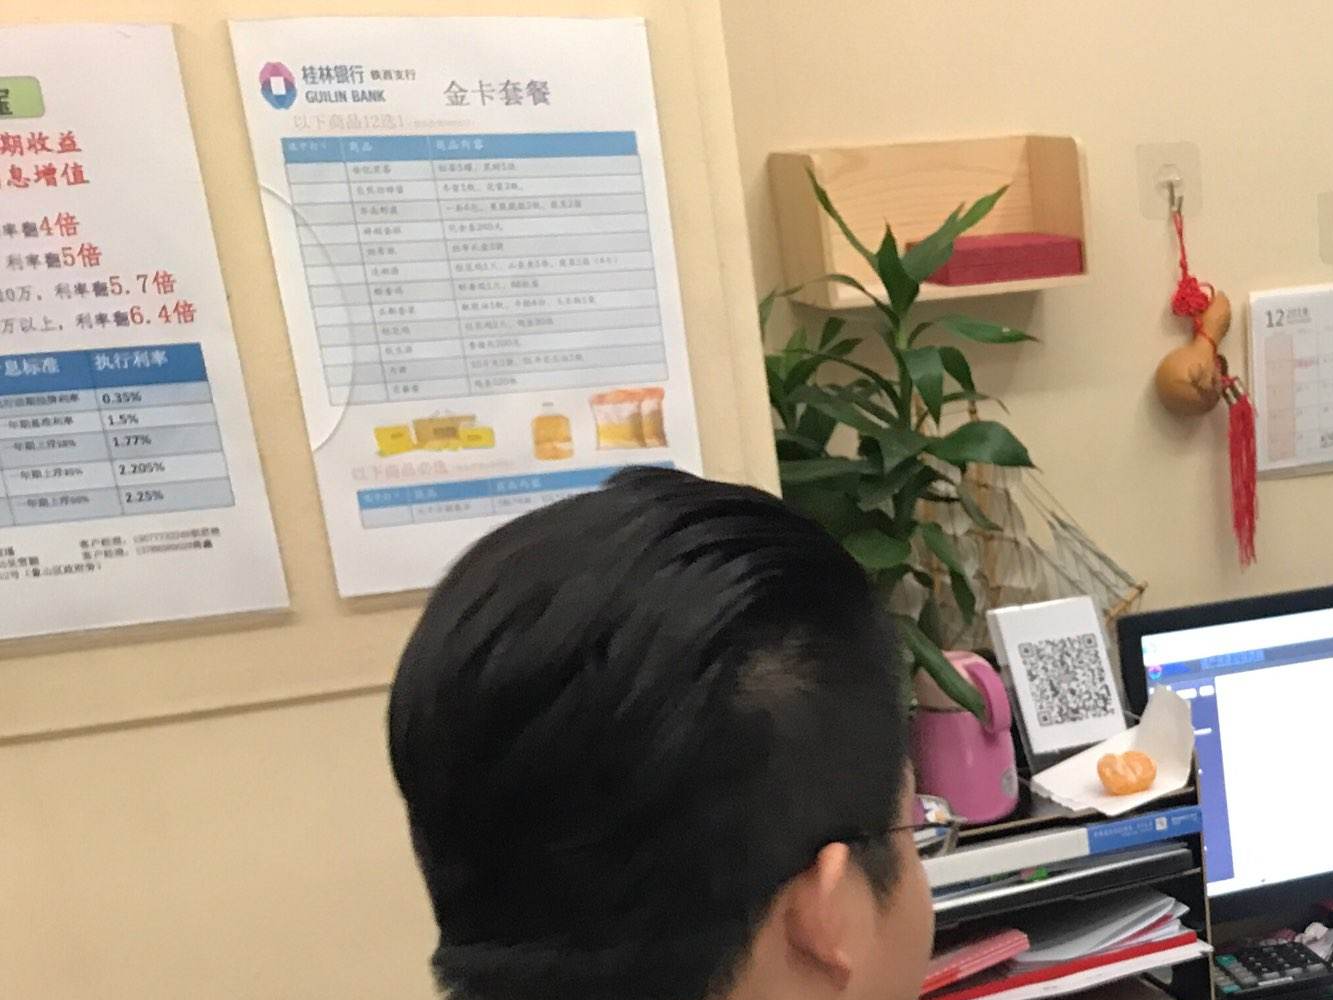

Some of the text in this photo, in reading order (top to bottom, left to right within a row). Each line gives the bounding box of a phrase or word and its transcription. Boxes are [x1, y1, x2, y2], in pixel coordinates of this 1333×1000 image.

[301, 64, 364, 85] 桂林银行
[305, 89, 386, 104] GUILIN BANK
[444, 79, 551, 106] 金卡套餐
[0, 131, 82, 156] 期收益
[7, 162, 90, 188] 息增值
[1265, 309, 1284, 328] 12
[96, 351, 168, 371] 执行利率
[108, 414, 139, 426] 1.5%
[113, 436, 152, 448] 1.77%
[125, 489, 164, 503] 2.25%
